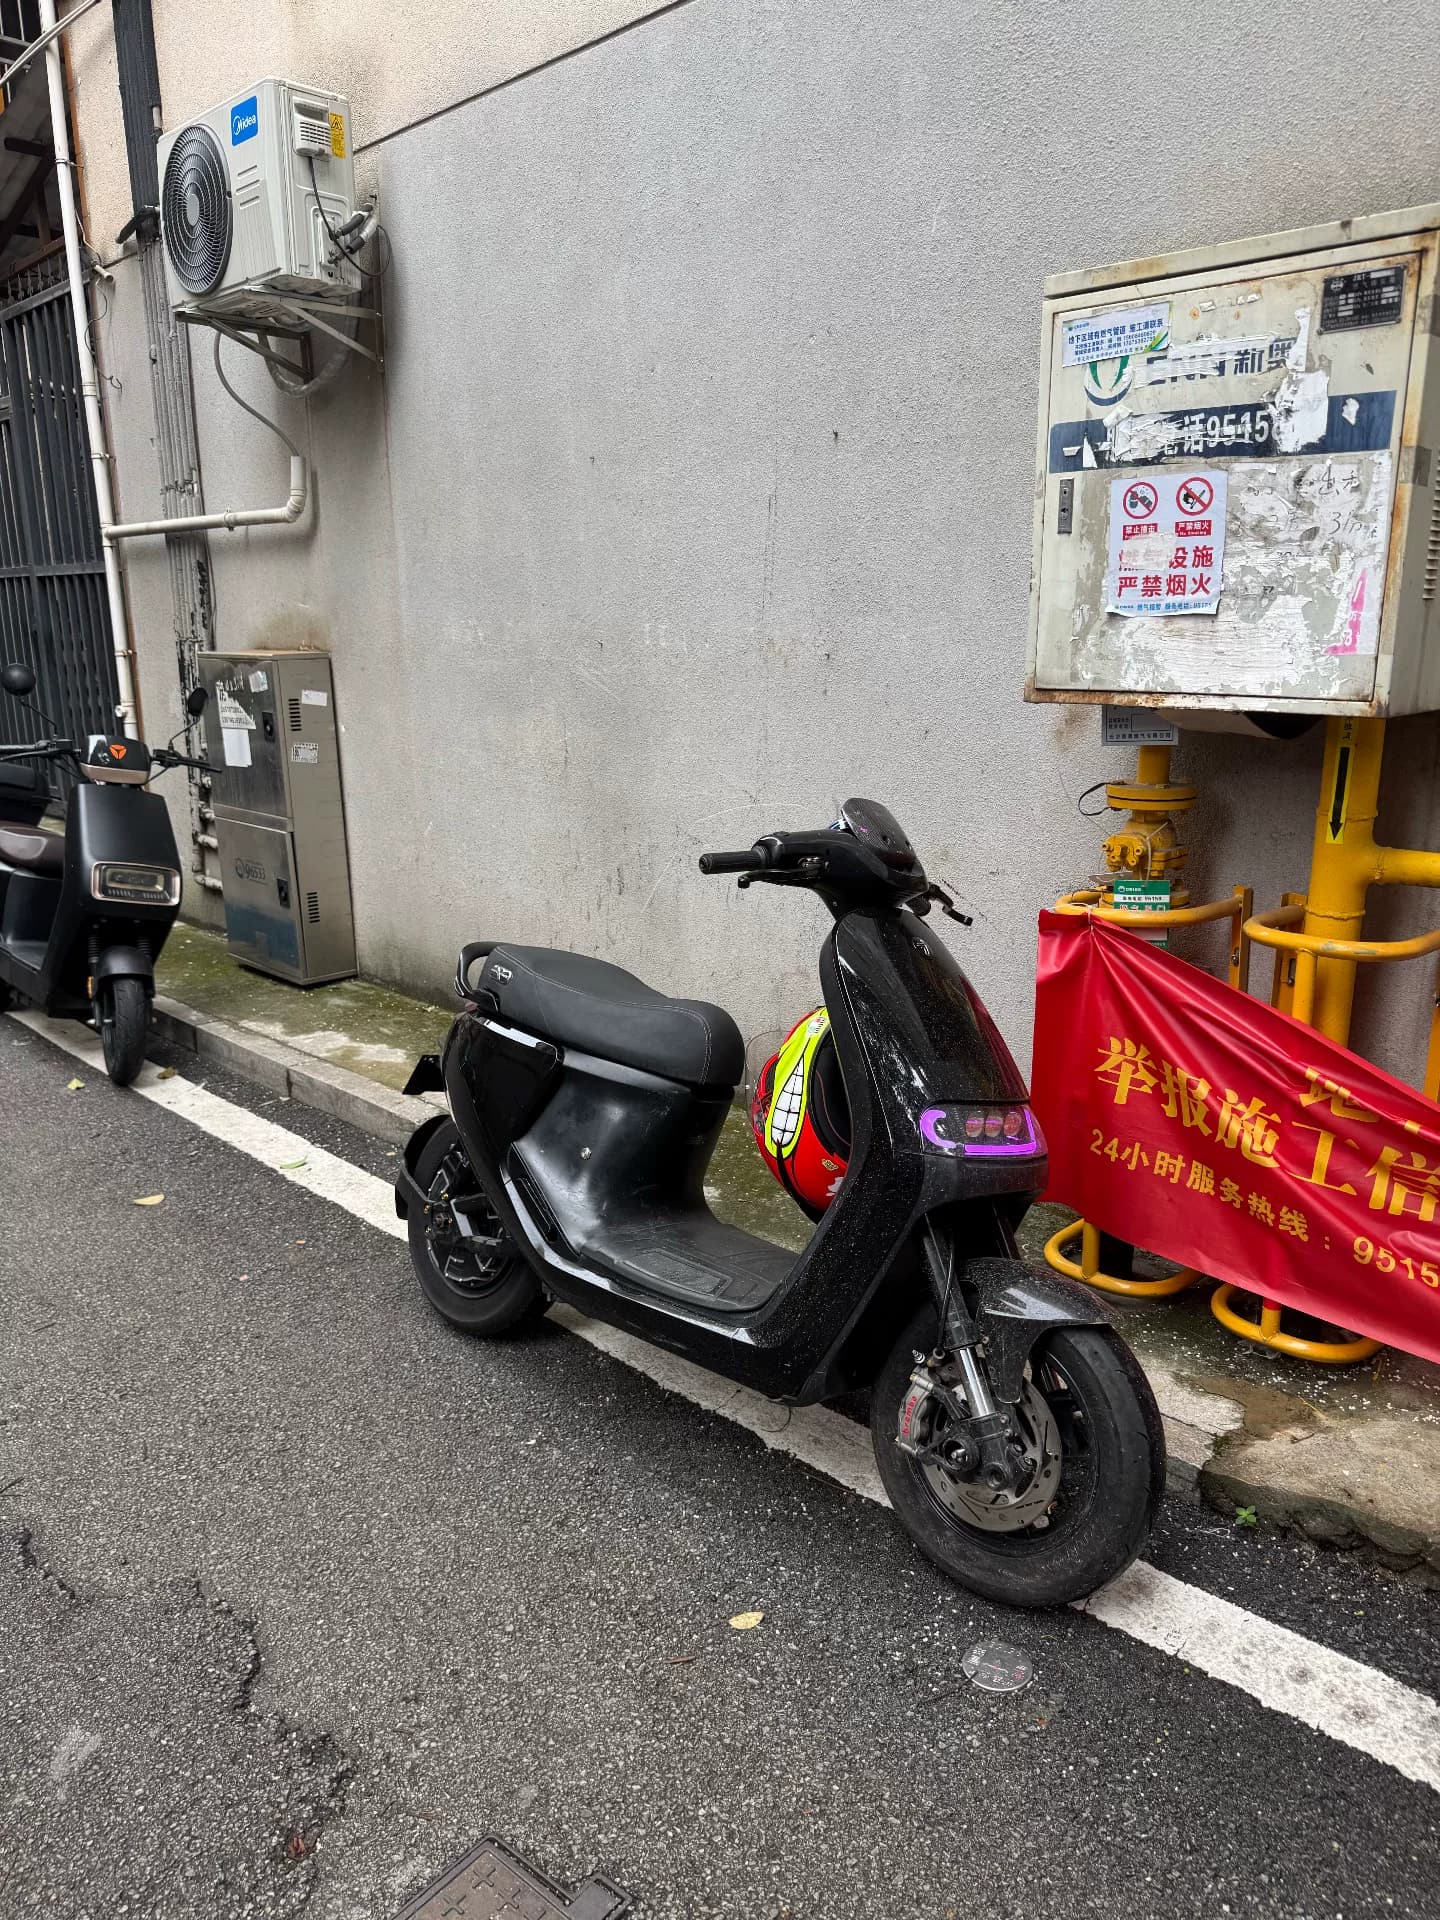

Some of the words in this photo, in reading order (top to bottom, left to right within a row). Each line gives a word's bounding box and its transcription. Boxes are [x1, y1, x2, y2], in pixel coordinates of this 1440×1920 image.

[233, 115, 257, 136] Midea
[1178, 521, 1209, 531] 严禁烟火
[1117, 572, 1212, 598] 严禁烟火
[901, 1395, 918, 1436] brembo
